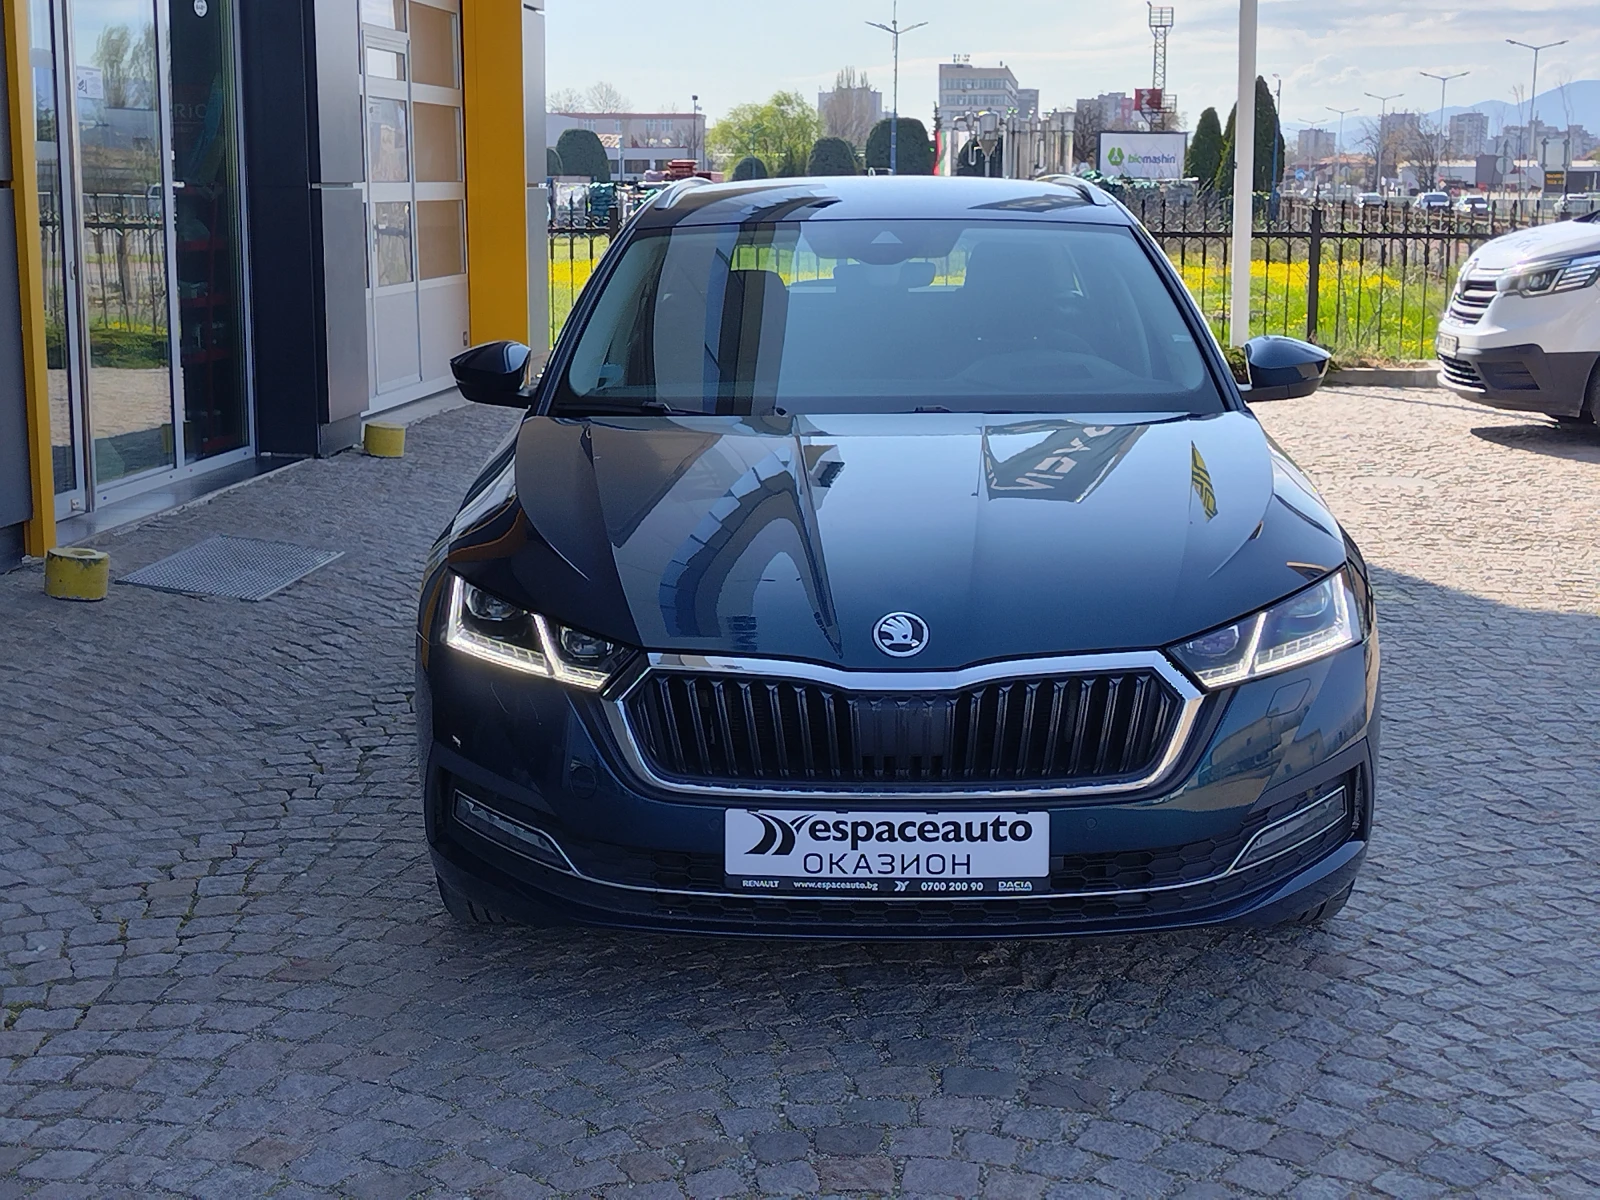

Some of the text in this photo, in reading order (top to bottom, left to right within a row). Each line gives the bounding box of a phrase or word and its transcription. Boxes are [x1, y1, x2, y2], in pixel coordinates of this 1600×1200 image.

[808, 815, 1032, 850] espaceauto
[803, 853, 971, 875] ОКАЗИОН
[742, 880, 1032, 891] RENAULT www.espaceauto.bg 0700 200 90 DACIA
